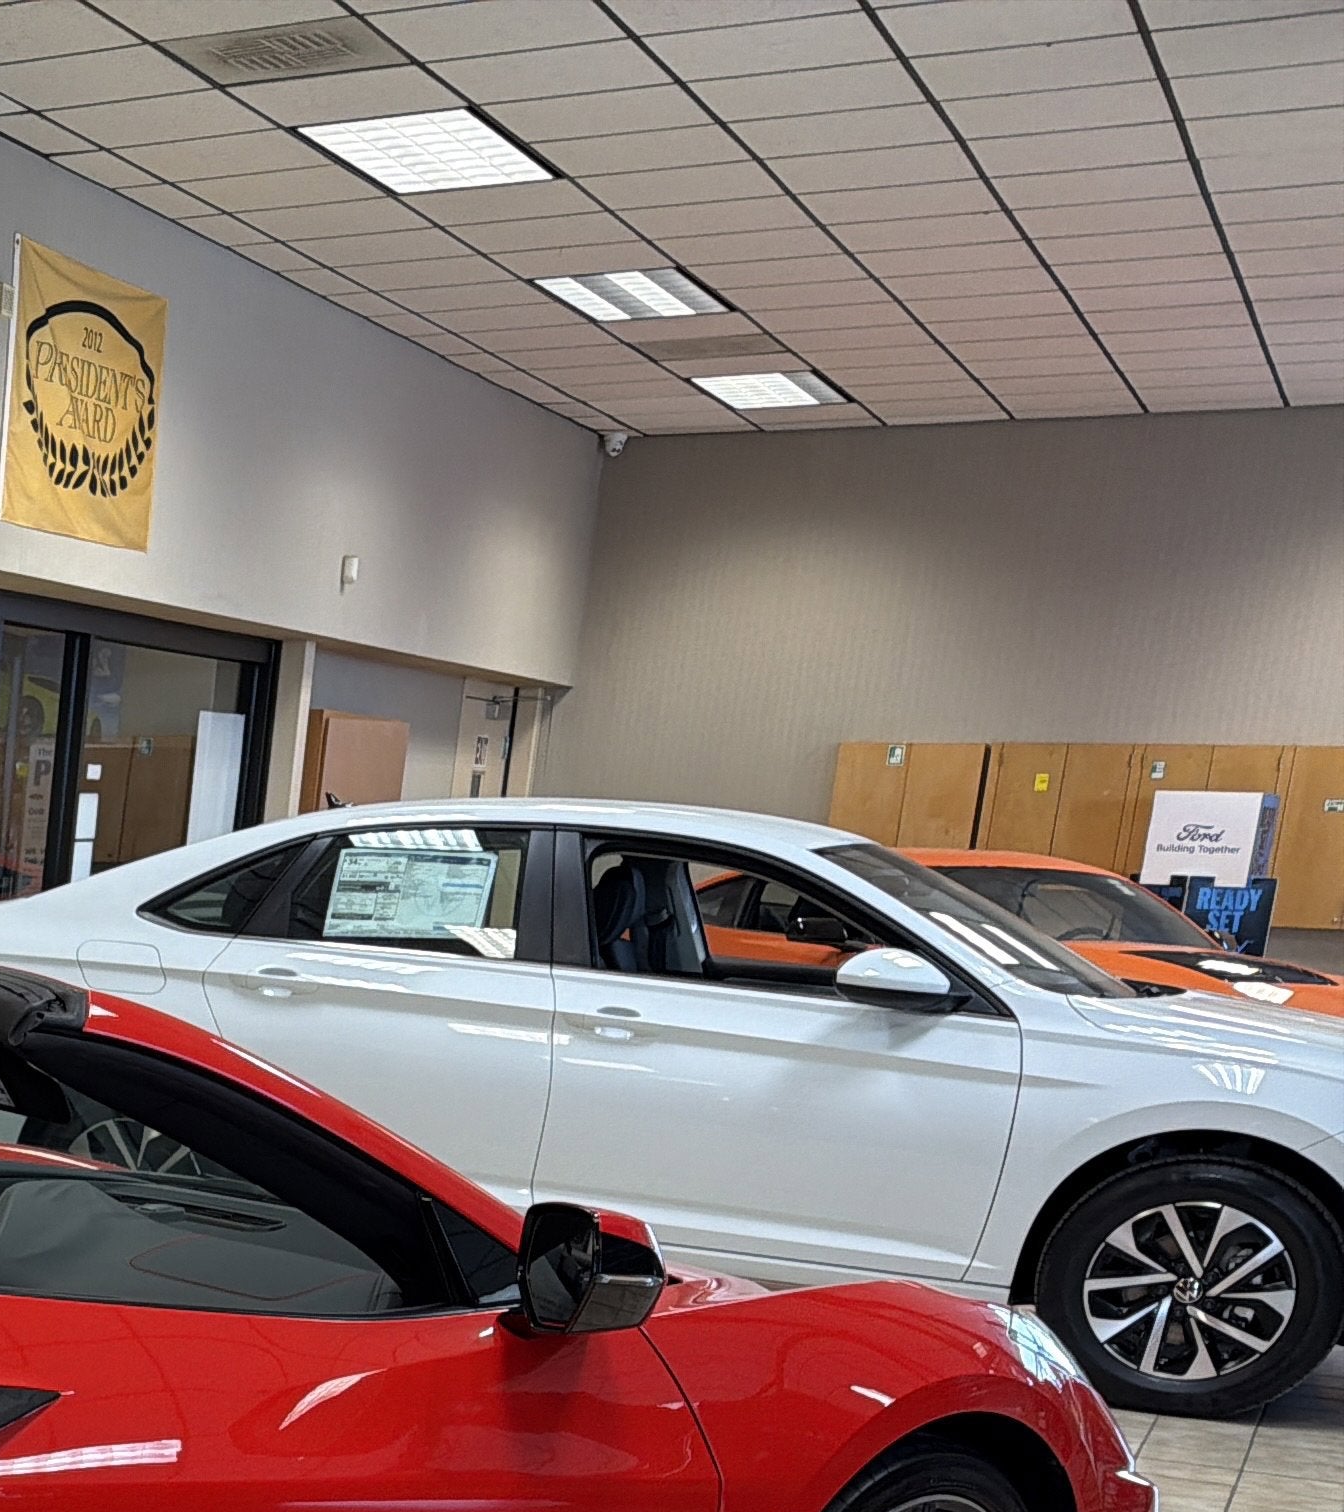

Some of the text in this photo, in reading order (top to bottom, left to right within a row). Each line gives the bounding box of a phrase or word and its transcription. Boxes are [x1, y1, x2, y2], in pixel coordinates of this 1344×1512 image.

[81, 326, 104, 354] 2012
[33, 340, 146, 413] PRESIDENT'S
[1176, 823, 1226, 843] Ford
[1156, 843, 1241, 855] Building Together
[1196, 887, 1263, 912] READY
[1206, 909, 1245, 934] SET
